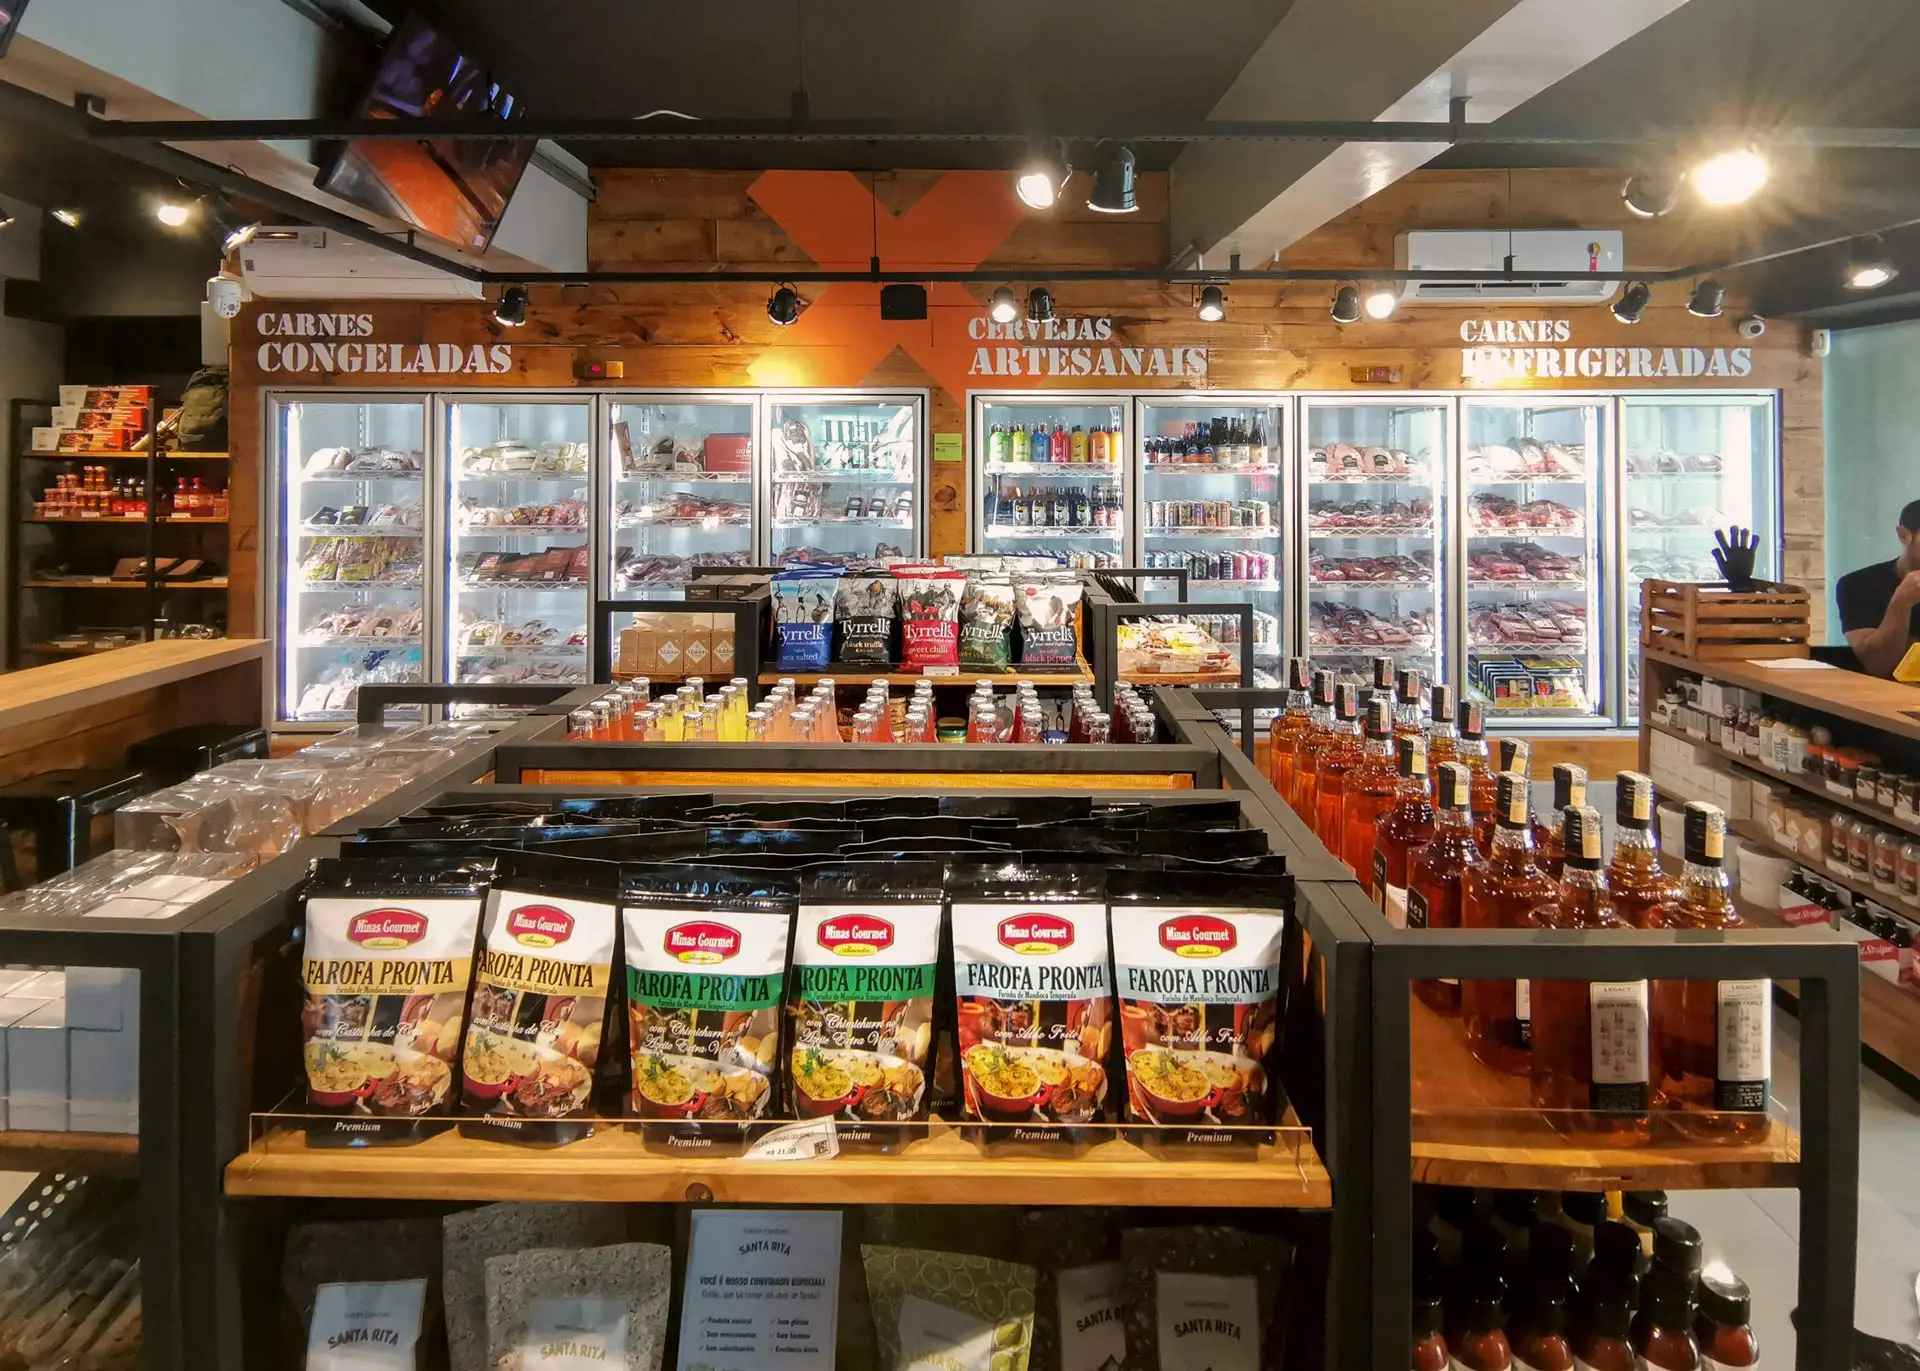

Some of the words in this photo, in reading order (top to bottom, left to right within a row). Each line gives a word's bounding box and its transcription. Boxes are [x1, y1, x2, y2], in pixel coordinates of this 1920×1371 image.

[257, 313, 374, 336] CARNES
[968, 317, 1112, 341] CERVEJAS
[1459, 319, 1571, 343] CARNES
[257, 342, 512, 373] CONGELADAS
[968, 347, 1209, 376] ARTESANAIS
[355, 919, 381, 933] Minas
[383, 919, 420, 934] Gourmet
[514, 913, 536, 928] Minas
[537, 917, 568, 933] Gourmet
[825, 925, 850, 940] Minas
[851, 925, 888, 940] Gourmet
[1004, 923, 1029, 938] Minas
[1031, 924, 1067, 939] Gourmet
[1166, 926, 1191, 940] Minas
[1192, 927, 1229, 941] Gourmet
[671, 931, 696, 947] Minas
[697, 932, 734, 948] Gourmet
[307, 960, 373, 985] FAROFA
[379, 960, 454, 985] PRONTA
[527, 957, 593, 988] PRONTA
[855, 967, 923, 992] PRONTA
[968, 963, 1034, 991] FAROFA
[1038, 964, 1104, 991] PRONTA
[1128, 967, 1197, 994] FAROFA
[1201, 968, 1270, 994] PRONTA
[698, 975, 770, 1002] PRONTA
[334, 1121, 381, 1132] Premium
[482, 1114, 523, 1130] Premium
[667, 1136, 712, 1148] Premium
[837, 1130, 871, 1140] emium
[1014, 1129, 1060, 1140] Premium
[1187, 1132, 1232, 1143] Premium
[739, 1241, 769, 1256] SANTA
[771, 1241, 792, 1257] RITA
[1076, 1308, 1112, 1333] SANTA
[1174, 1319, 1213, 1338] SANTA
[1215, 1319, 1241, 1342] RITA
[328, 1328, 369, 1350] SANTA
[371, 1328, 399, 1347] RITA
[540, 1342, 577, 1360] SANTA
[579, 1344, 607, 1361] RITA
